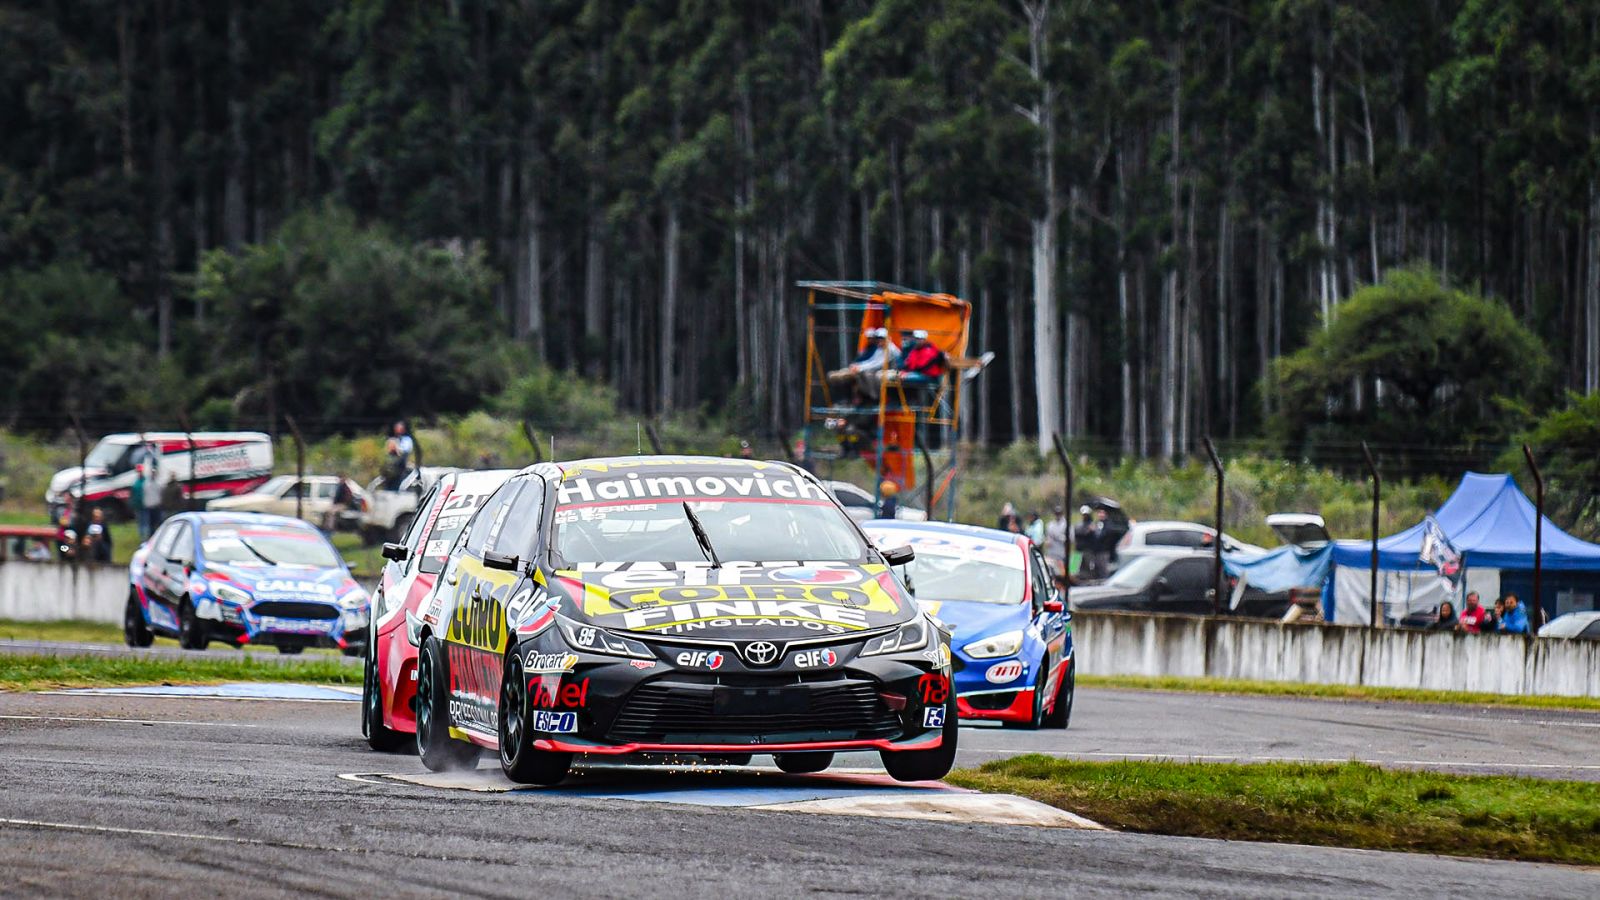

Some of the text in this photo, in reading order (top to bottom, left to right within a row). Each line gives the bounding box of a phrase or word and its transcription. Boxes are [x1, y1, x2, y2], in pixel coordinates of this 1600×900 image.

[554, 472, 829, 504] Haimovich
[609, 585, 871, 611] COIRO
[623, 600, 868, 628] FINKE
[655, 617, 846, 634] TINGLADOS
[578, 627, 597, 646] 95
[524, 650, 566, 670] Brocart
[676, 652, 706, 667] elf
[794, 652, 821, 668] elf
[535, 711, 576, 731] ESCO
